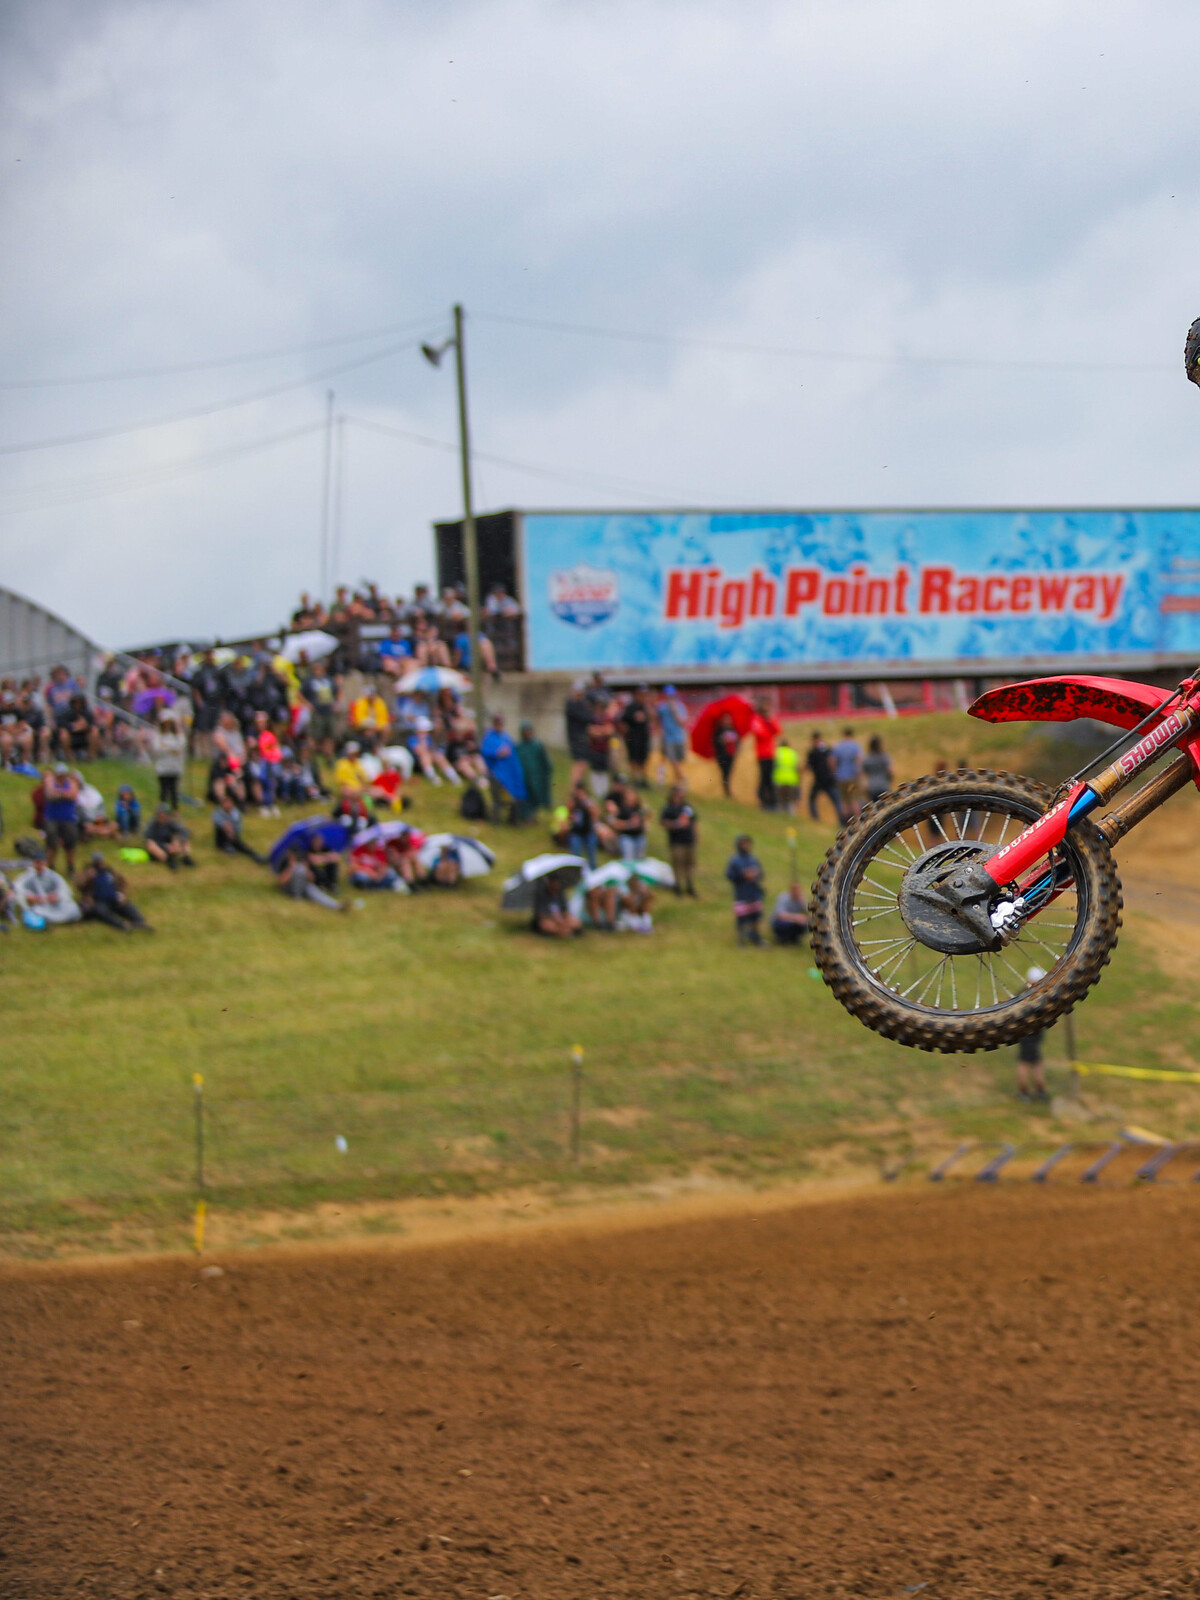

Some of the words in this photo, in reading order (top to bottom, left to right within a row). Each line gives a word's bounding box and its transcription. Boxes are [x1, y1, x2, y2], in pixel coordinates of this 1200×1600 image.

[664, 568, 777, 629] High
[784, 564, 909, 617] Point
[919, 568, 1124, 624] Raceway
[1120, 714, 1183, 776] SHOWA
[998, 799, 1069, 859] DUNLOP
